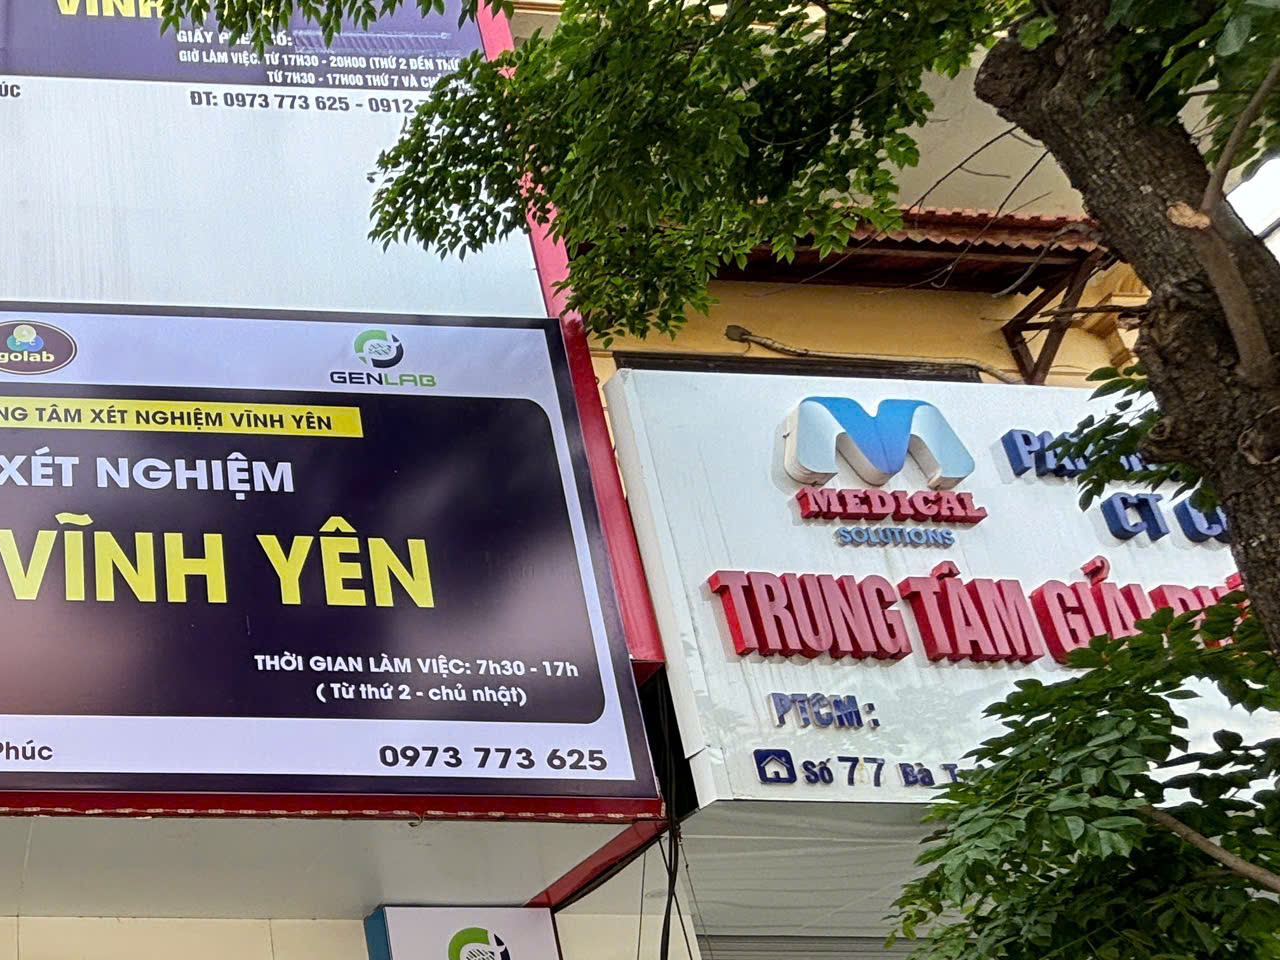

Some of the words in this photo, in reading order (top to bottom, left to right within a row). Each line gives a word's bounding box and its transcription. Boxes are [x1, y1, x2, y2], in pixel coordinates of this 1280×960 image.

[177, 27, 213, 43] GIẤY
[179, 48, 200, 62] GIỜ
[202, 49, 229, 64] LÀM
[282, 54, 319, 67] 17H30
[330, 56, 366, 68] 20H00
[399, 58, 407, 69] 2
[285, 72, 315, 84] 7H30
[328, 73, 363, 86] 17H00
[365, 73, 389, 87] THỨ
[391, 75, 399, 87] 7
[402, 74, 419, 88] VÀ
[190, 91, 218, 106] ĐT:
[223, 92, 269, 108] 0973
[274, 94, 310, 110] 773
[316, 95, 350, 111] 625
[368, 97, 415, 113] 0912
[330, 371, 437, 387] GENLAB
[35, 404, 82, 423] TÂM
[90, 405, 128, 424] XÉT
[135, 408, 223, 431] NGHIỆM
[230, 410, 284, 428] VĨNH
[291, 412, 332, 430] YÊN
[96, 451, 296, 500] NGHIỆM
[795, 487, 988, 525] MEDICAL
[1100, 492, 1169, 542] CT
[834, 527, 955, 549] SOLUTIONS
[257, 516, 435, 608] YÊN
[707, 569, 912, 661] TRUNG
[898, 560, 1045, 664] TÂM
[254, 651, 303, 671] THỜI
[309, 656, 363, 672] GIAN
[369, 653, 412, 673] LÀM
[417, 655, 471, 678] VIỆC:
[476, 659, 525, 676] 7h30
[543, 661, 578, 677] 17h
[330, 682, 354, 699] Từ
[359, 683, 392, 699] thứ
[398, 684, 412, 700] 2
[428, 683, 466, 702] chủ
[472, 685, 527, 707] nhật)
[379, 745, 462, 768] 0973
[474, 747, 535, 769] 773
[546, 748, 607, 771] 625
[801, 757, 834, 784] Số
[837, 756, 886, 787] 77
